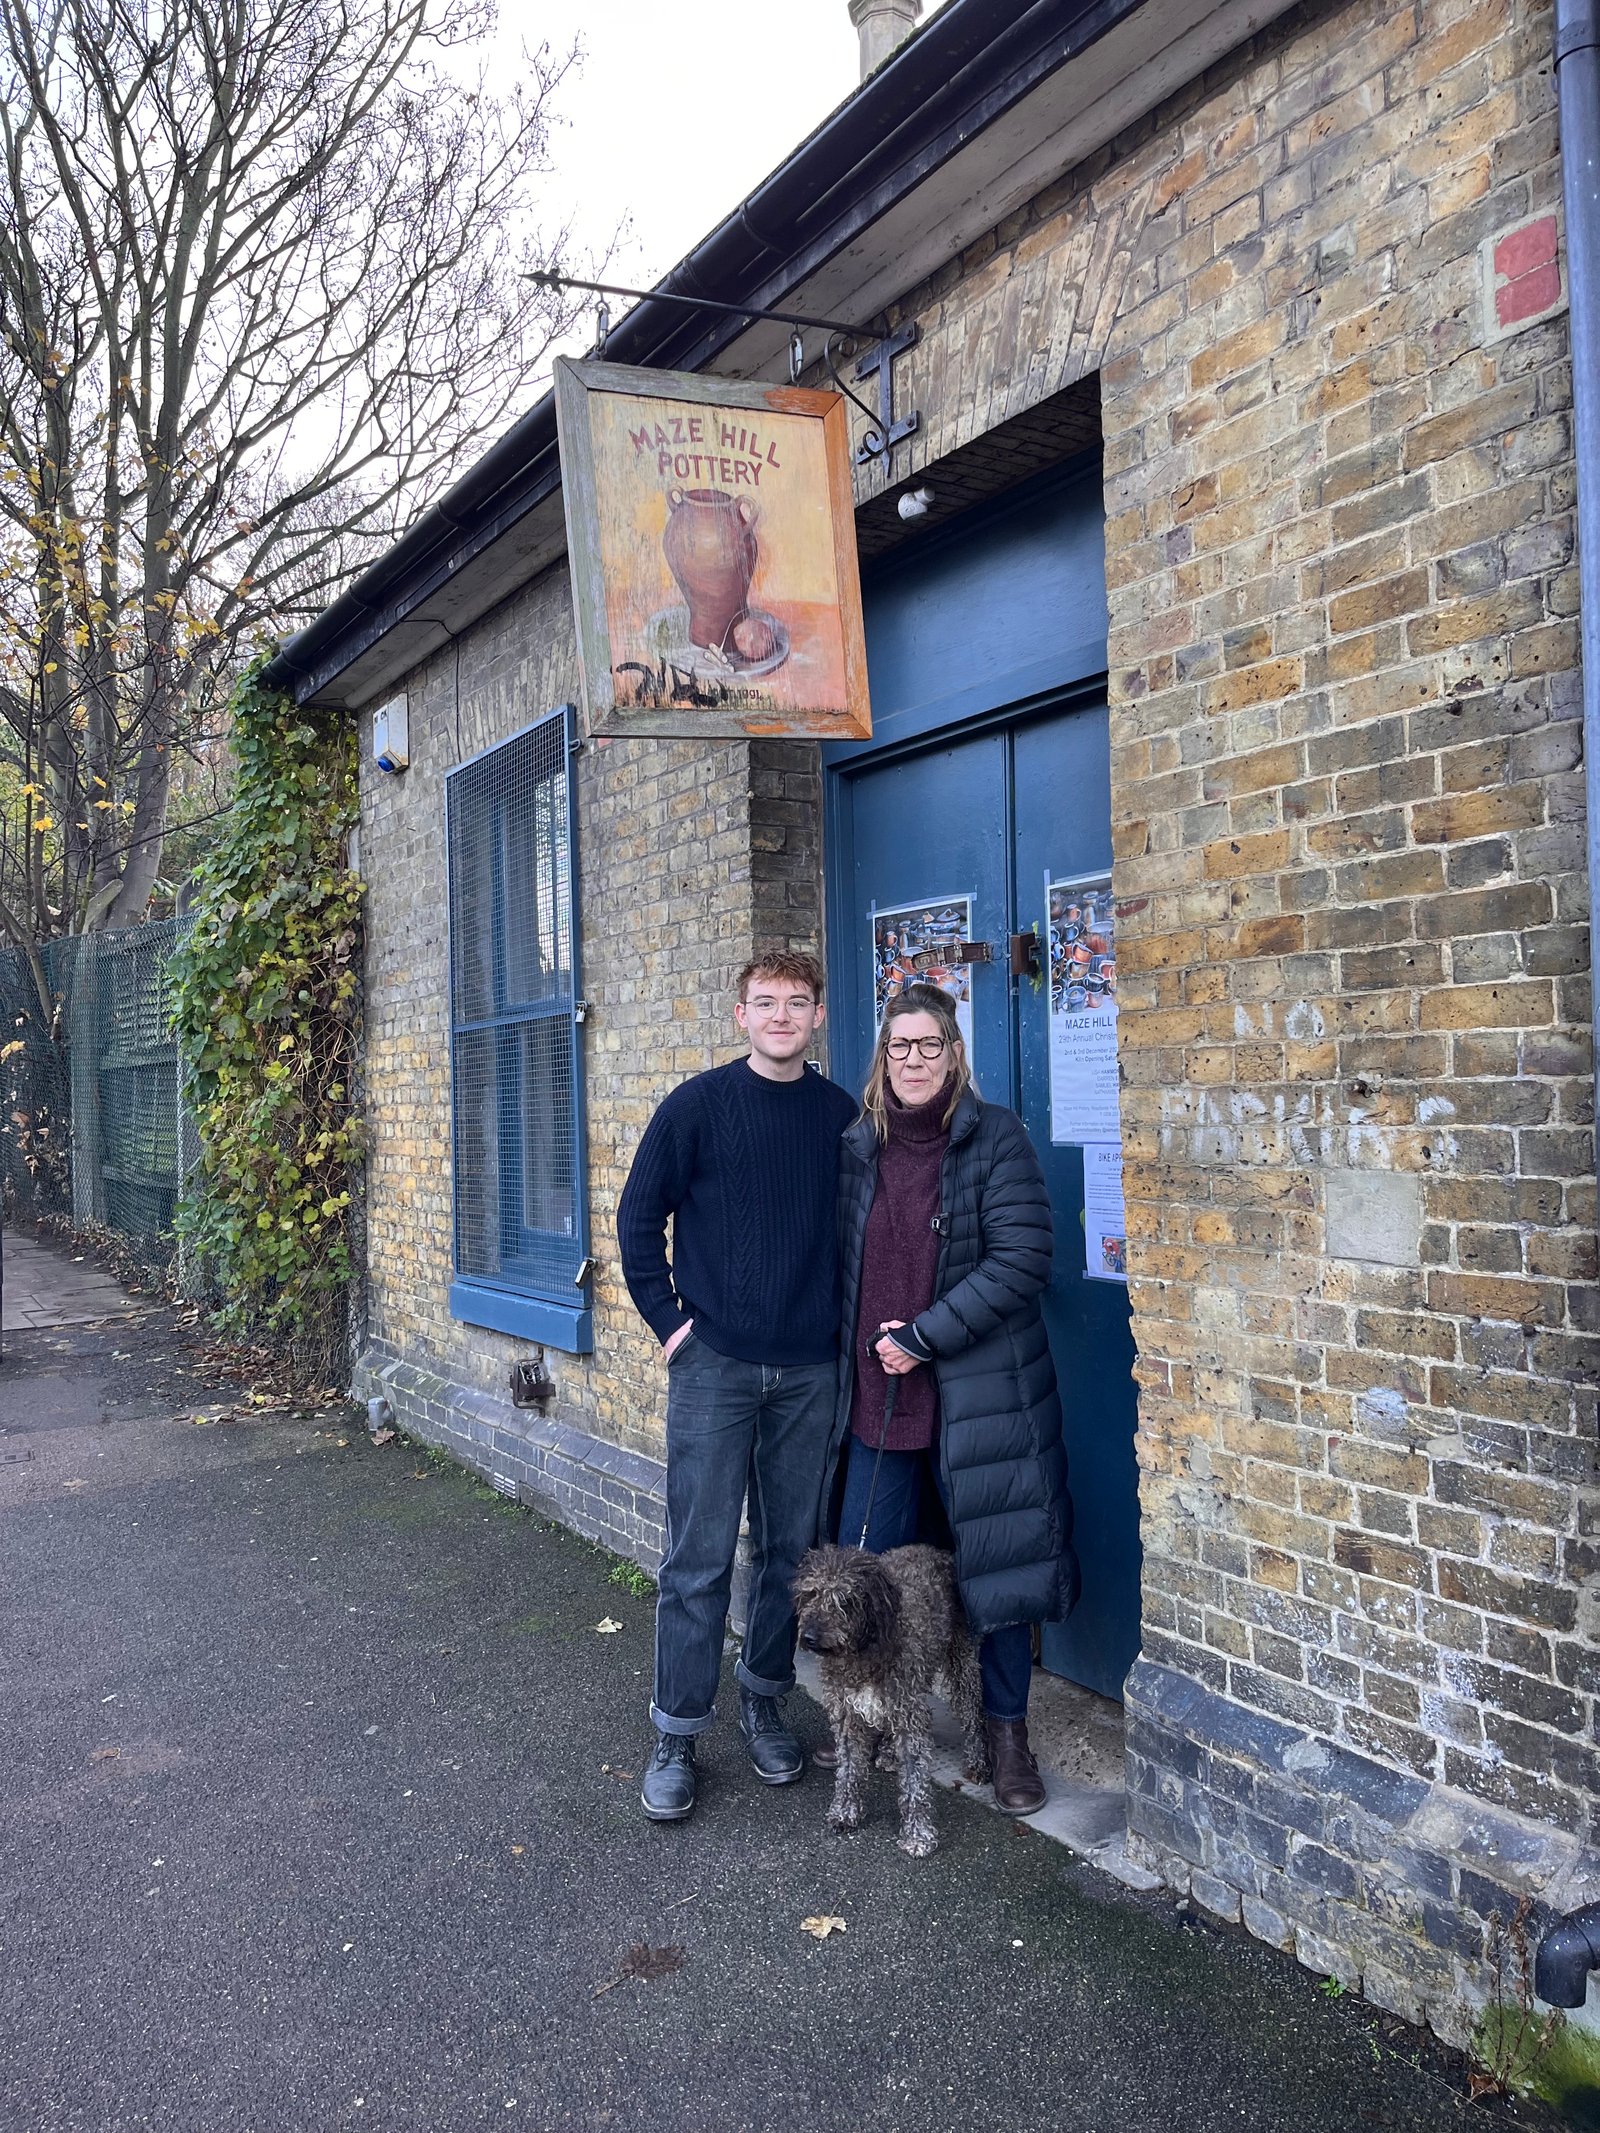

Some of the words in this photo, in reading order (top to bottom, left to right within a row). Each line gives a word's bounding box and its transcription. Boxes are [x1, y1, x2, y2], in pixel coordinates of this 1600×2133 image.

[628, 417, 704, 454] MAZE
[720, 422, 781, 469] HILL
[657, 451, 763, 487] POTTERY
[1066, 1017, 1090, 1030] MAZE
[1092, 1015, 1112, 1028] HILL
[1233, 999, 1325, 1040] NO
[1072, 1033, 1094, 1043] Annual
[1098, 1152, 1110, 1162] BIKE
